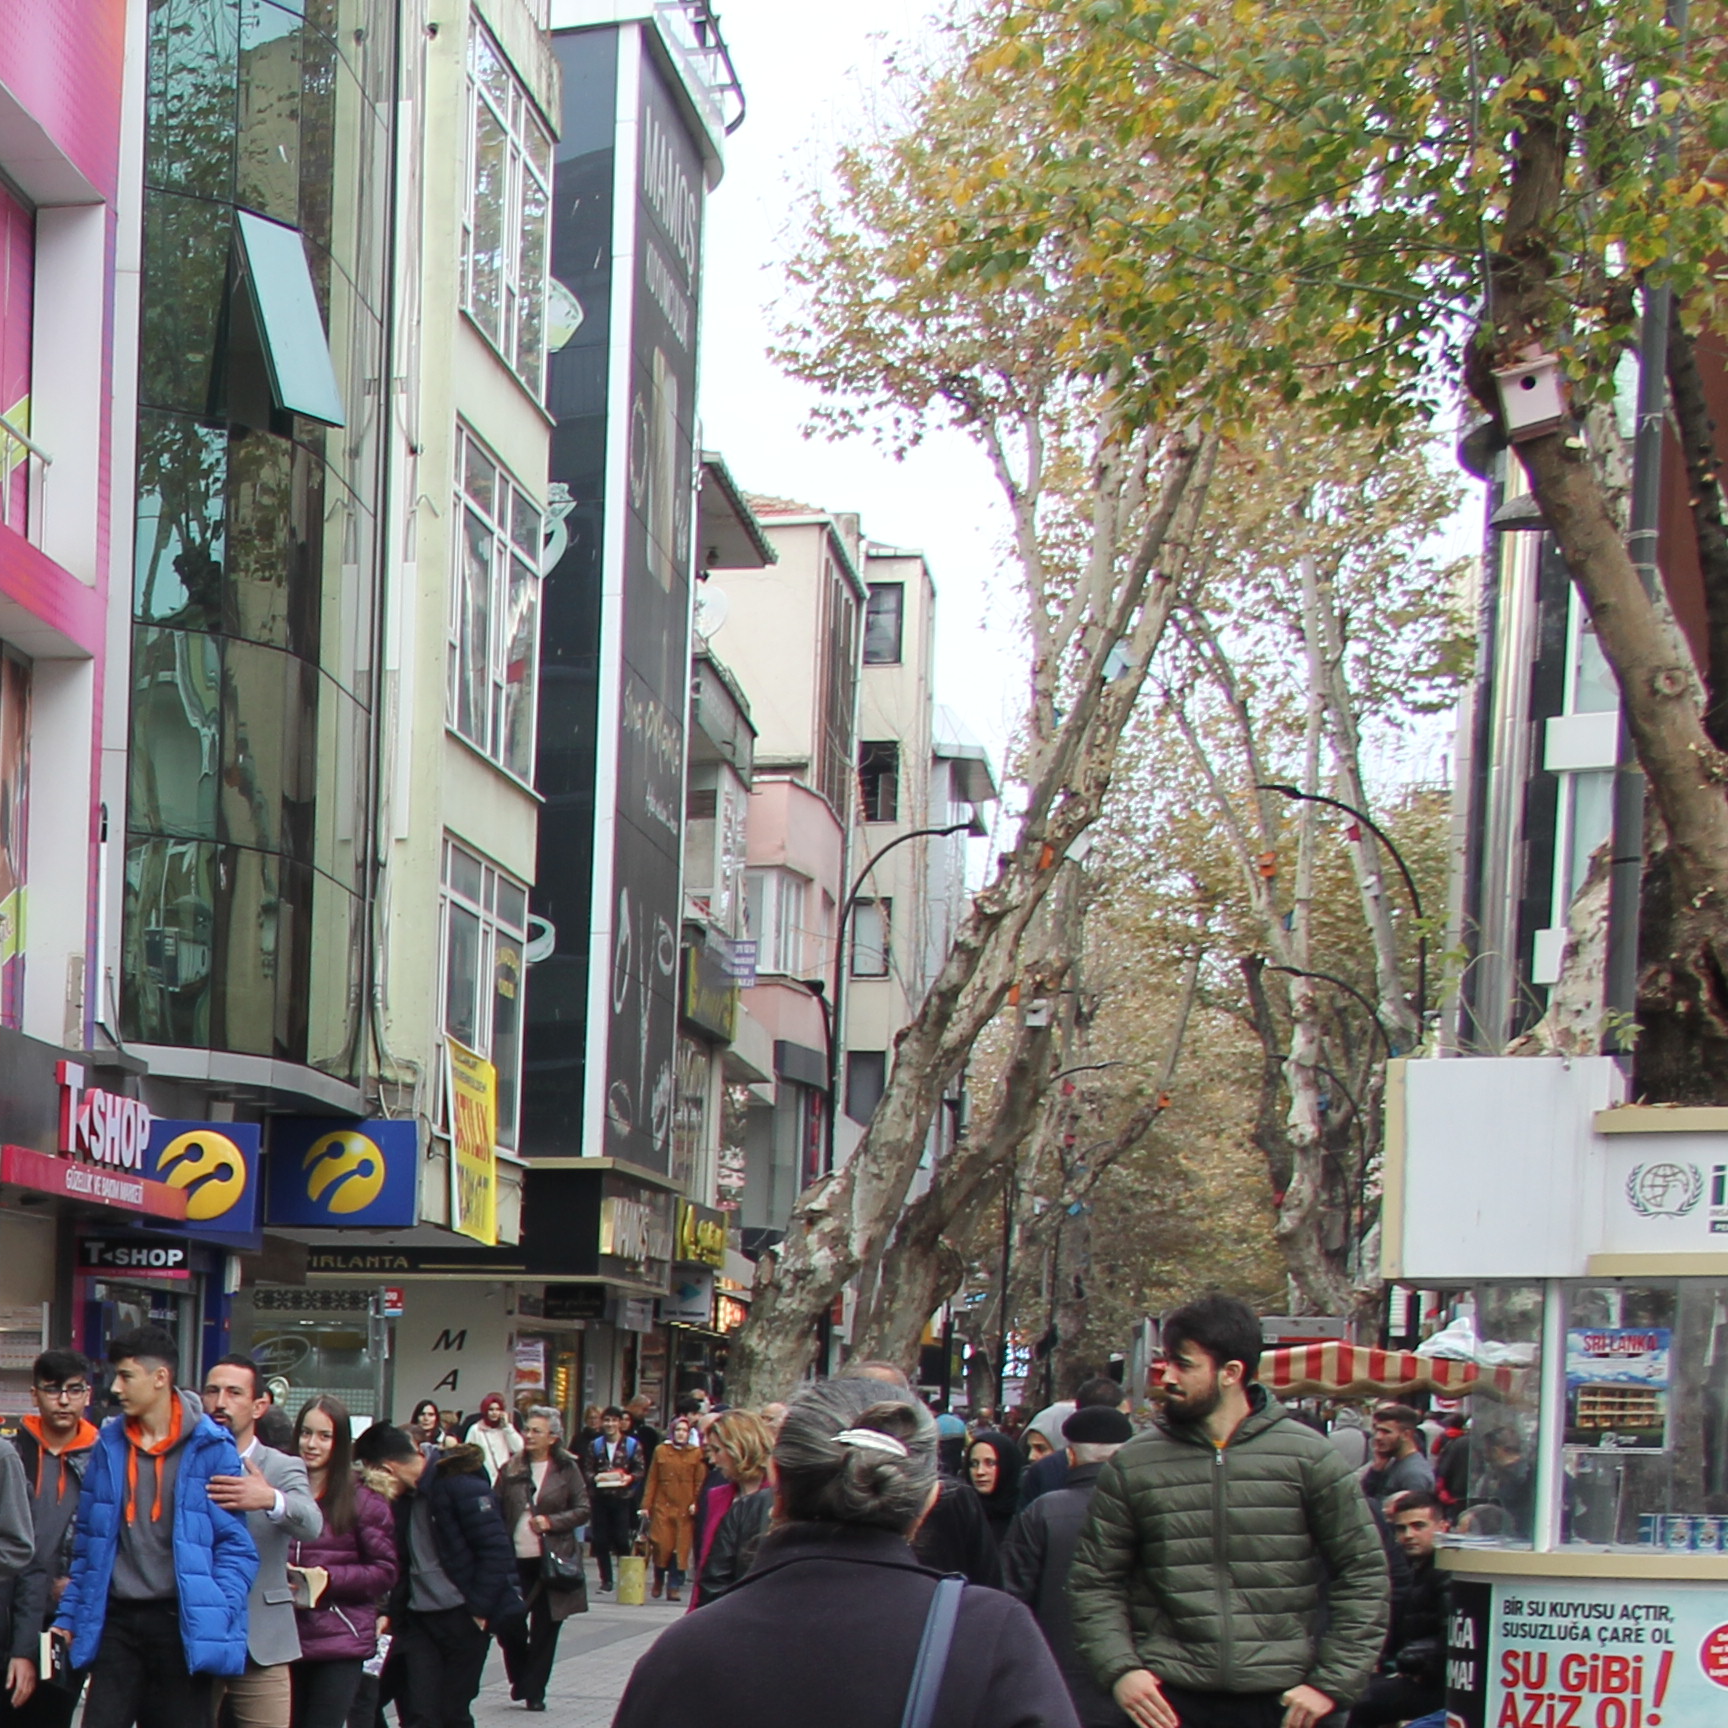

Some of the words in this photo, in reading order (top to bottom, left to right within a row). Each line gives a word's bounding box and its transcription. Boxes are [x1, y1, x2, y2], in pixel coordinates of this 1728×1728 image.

[307, 1254, 410, 1269] IRLANTA
[1502, 1595, 1524, 1617] BİR
[1527, 1600, 1546, 1618] SU
[1549, 1601, 1615, 1621] KUYUSU
[1619, 1603, 1675, 1626] AÇTIR,
[1501, 1619, 1592, 1643] SUSUZLUĞA
[1596, 1625, 1645, 1648] ÇARE
[1650, 1627, 1675, 1645] OL
[1499, 1649, 1549, 1690] SU
